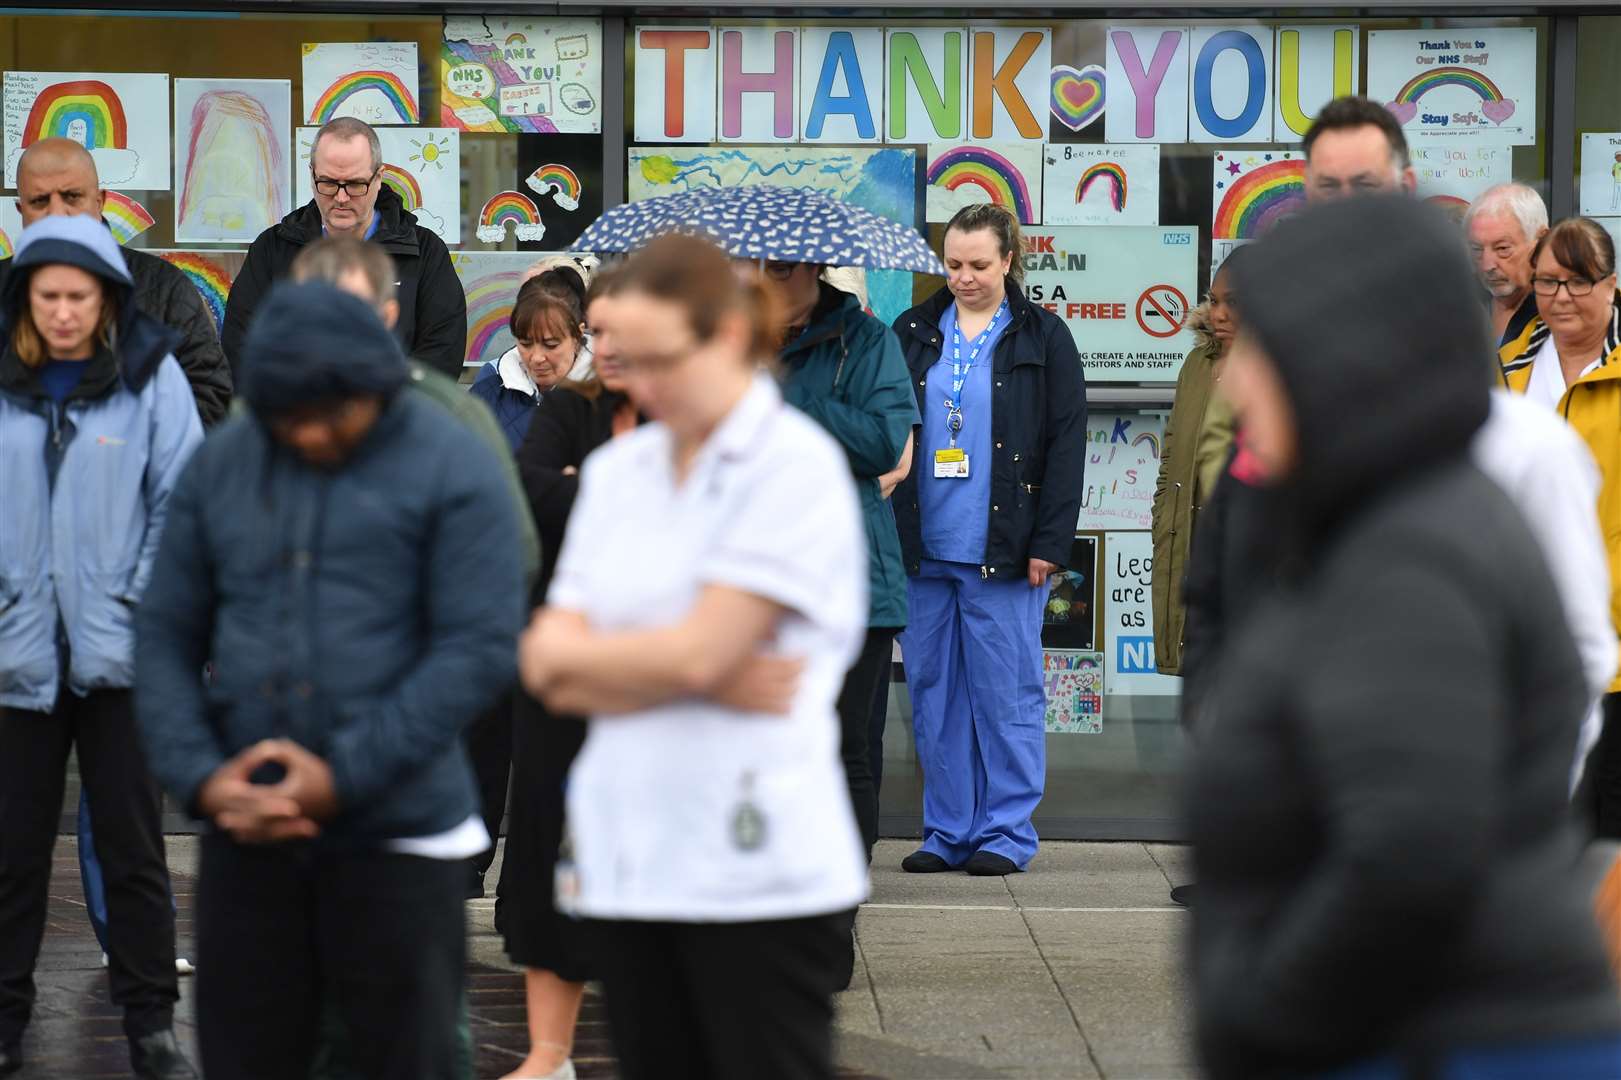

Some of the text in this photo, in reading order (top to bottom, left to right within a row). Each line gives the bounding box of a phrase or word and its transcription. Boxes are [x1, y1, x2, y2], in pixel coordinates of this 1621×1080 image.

[1419, 40, 1486, 50] Thank You to
[1416, 53, 1488, 65] Our NHS Staff
[453, 69, 483, 82] NHS
[520, 65, 561, 81] YOU!
[640, 30, 1353, 138] THANK YOU
[353, 104, 384, 119] NHS
[1421, 113, 1448, 125] Stay
[1452, 111, 1479, 125] Safe
[1164, 233, 1191, 244] NHS
[1026, 285, 1067, 300] IS A
[1067, 303, 1126, 319] FREE
[1091, 352, 1124, 361] CREATE
[1136, 352, 1183, 361] HEALTHIER
[1082, 361, 1173, 369] VISITORS AND STAFF
[1112, 587, 1146, 603] are
[1121, 611, 1145, 627] as
